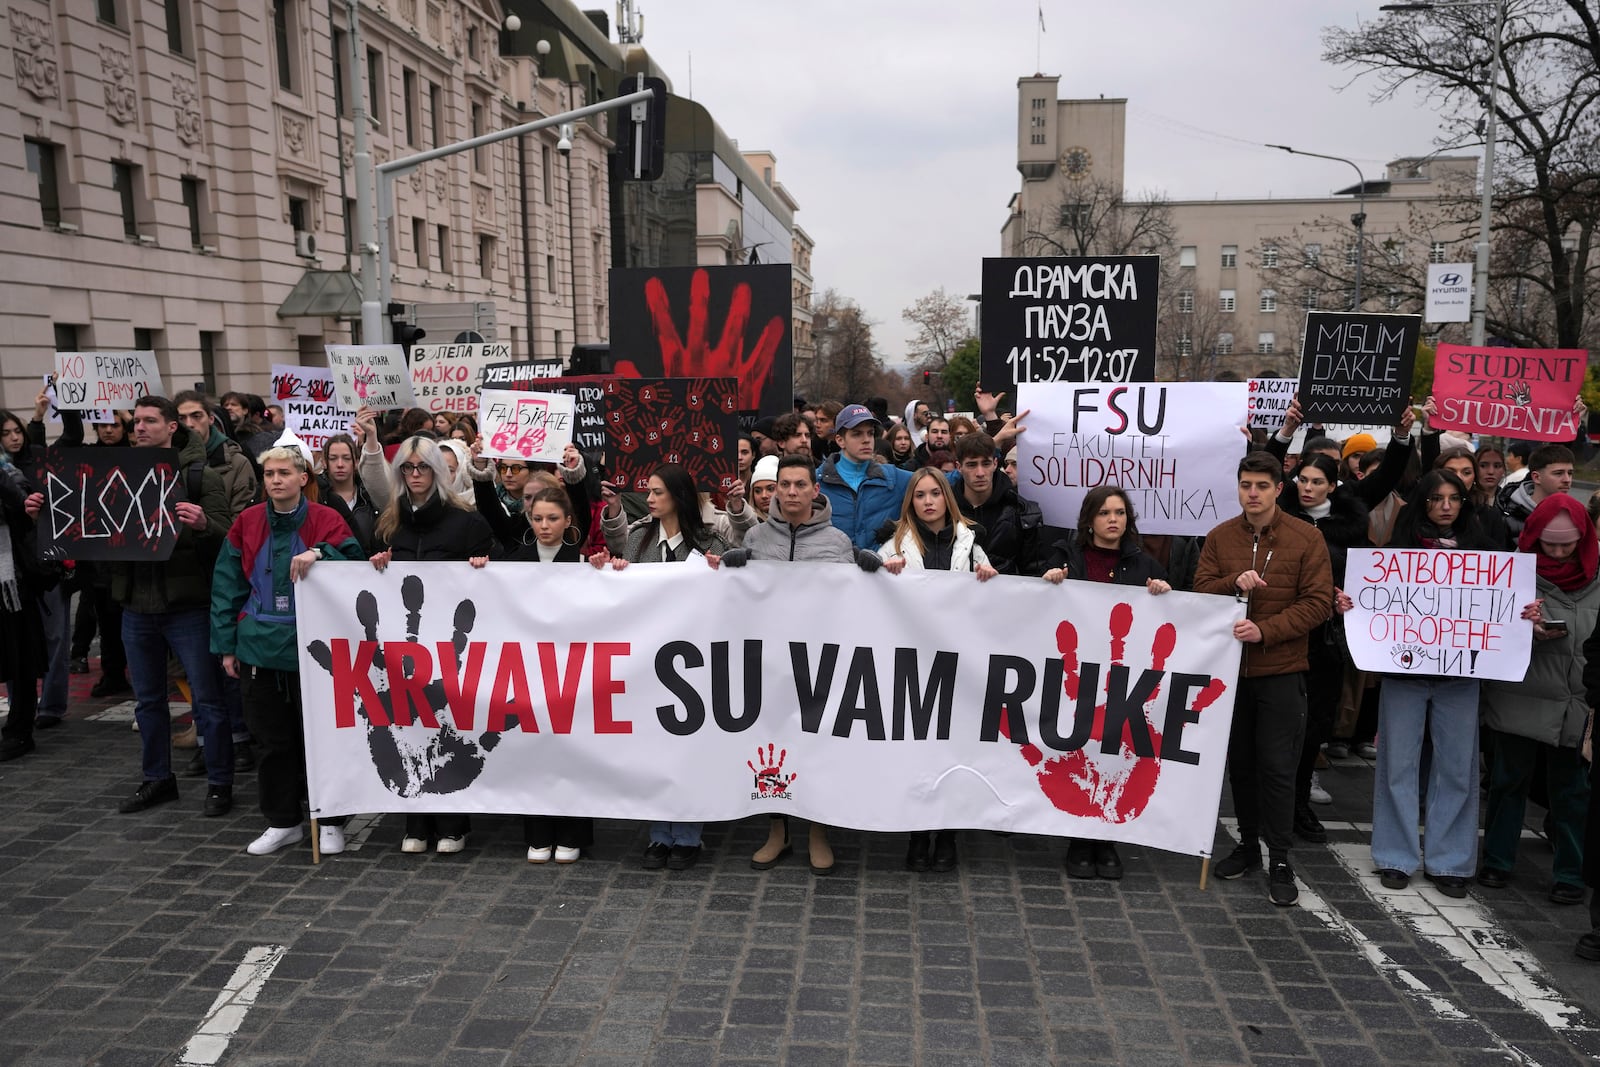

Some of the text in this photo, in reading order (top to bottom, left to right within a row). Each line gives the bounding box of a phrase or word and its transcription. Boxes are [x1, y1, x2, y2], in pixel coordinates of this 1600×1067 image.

[1009, 263, 1138, 300] ДРАМСКА
[1025, 303, 1111, 341] ПАУЗА
[482, 345, 509, 358] БИХ
[1316, 321, 1406, 355] MISLIM
[61, 356, 148, 379] КО РЕЖИРА
[413, 362, 468, 383] МАЈКО
[1006, 346, 1139, 385] 11:52-12:07
[1313, 354, 1401, 381] DAKLE
[1448, 353, 1579, 382] STUDENT
[61, 382, 87, 404] ОВУ
[644, 389, 652, 399] 2
[1248, 380, 1298, 393] ФАКУЛТ
[1311, 384, 1401, 402] PROTESTUJEM
[1466, 379, 1503, 400] za
[430, 396, 480, 412] СНЕВ
[1072, 386, 1167, 435] FSU
[1441, 398, 1577, 435] STUDENTA
[299, 418, 349, 431] ДАКЛЕ
[1247, 413, 1287, 426] УМЕТН
[1052, 432, 1170, 458] FAKULTET
[1030, 455, 1176, 488] SOLIDARNIH
[47, 467, 180, 540] BLOCK
[1088, 488, 1218, 520] TNIKA
[1363, 551, 1514, 588] ЗАТВОРЕНИ
[1358, 585, 1516, 623] ФАКУЛТЕТИ
[1369, 613, 1504, 651] ОТВОРЕНЕ
[330, 638, 1212, 766] KRVAVE SU VAM RUKE
